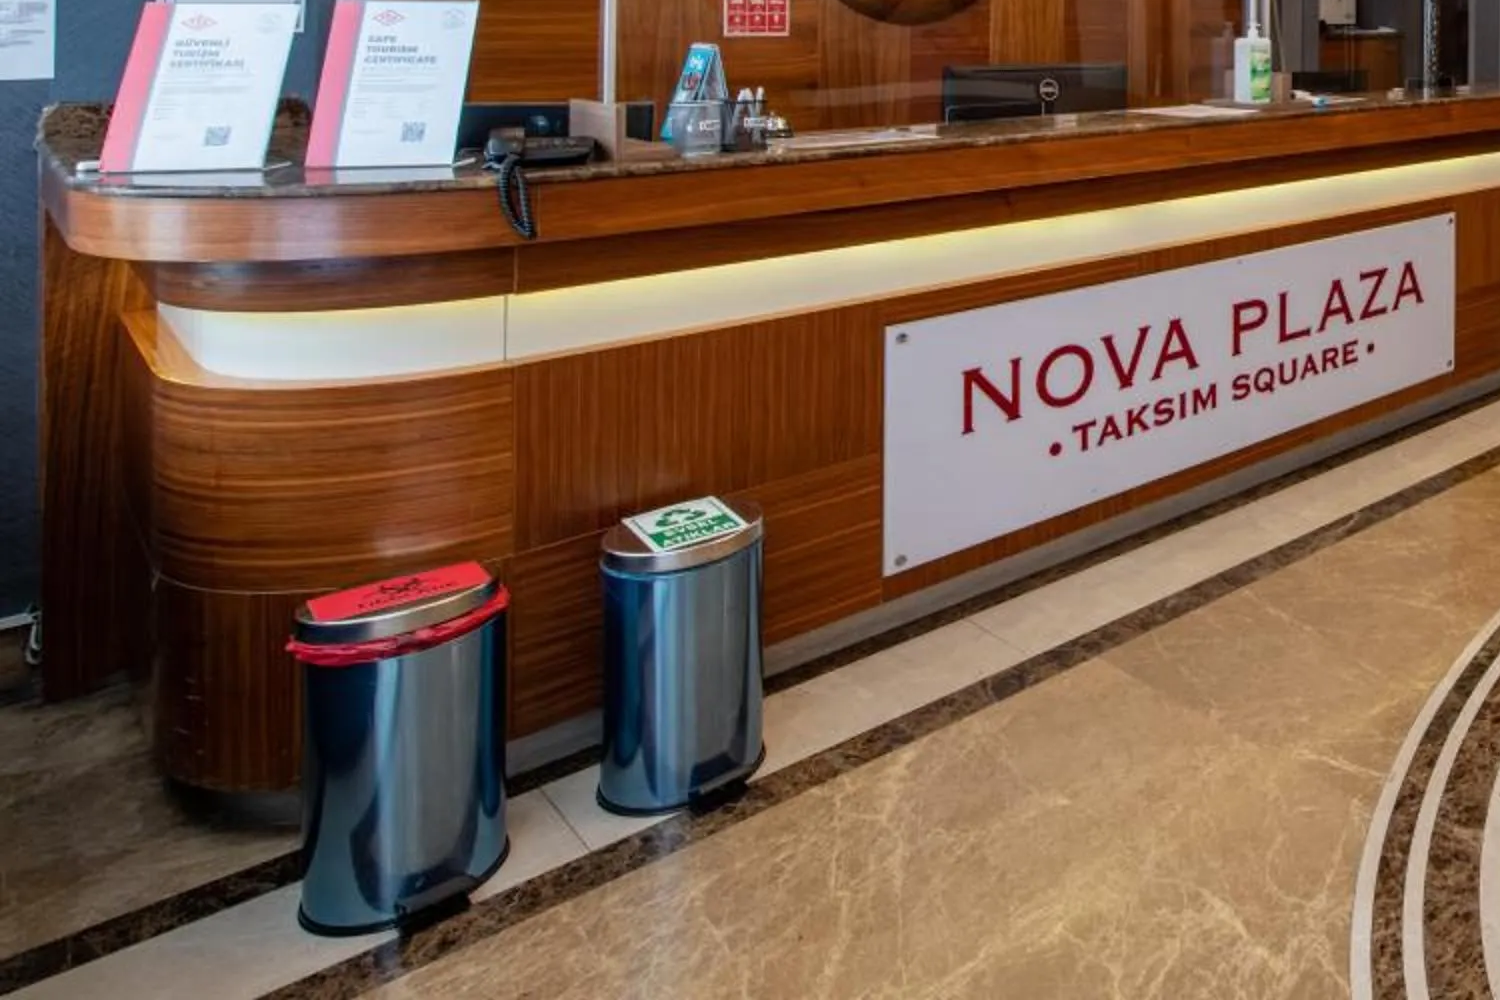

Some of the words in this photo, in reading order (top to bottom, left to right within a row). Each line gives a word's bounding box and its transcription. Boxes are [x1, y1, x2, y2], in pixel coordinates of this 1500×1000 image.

[960, 317, 1199, 436] NOVA
[1230, 260, 1425, 357] PLAZA
[1072, 382, 1218, 452] TAKSIM
[1231, 339, 1360, 401] SQUARE
